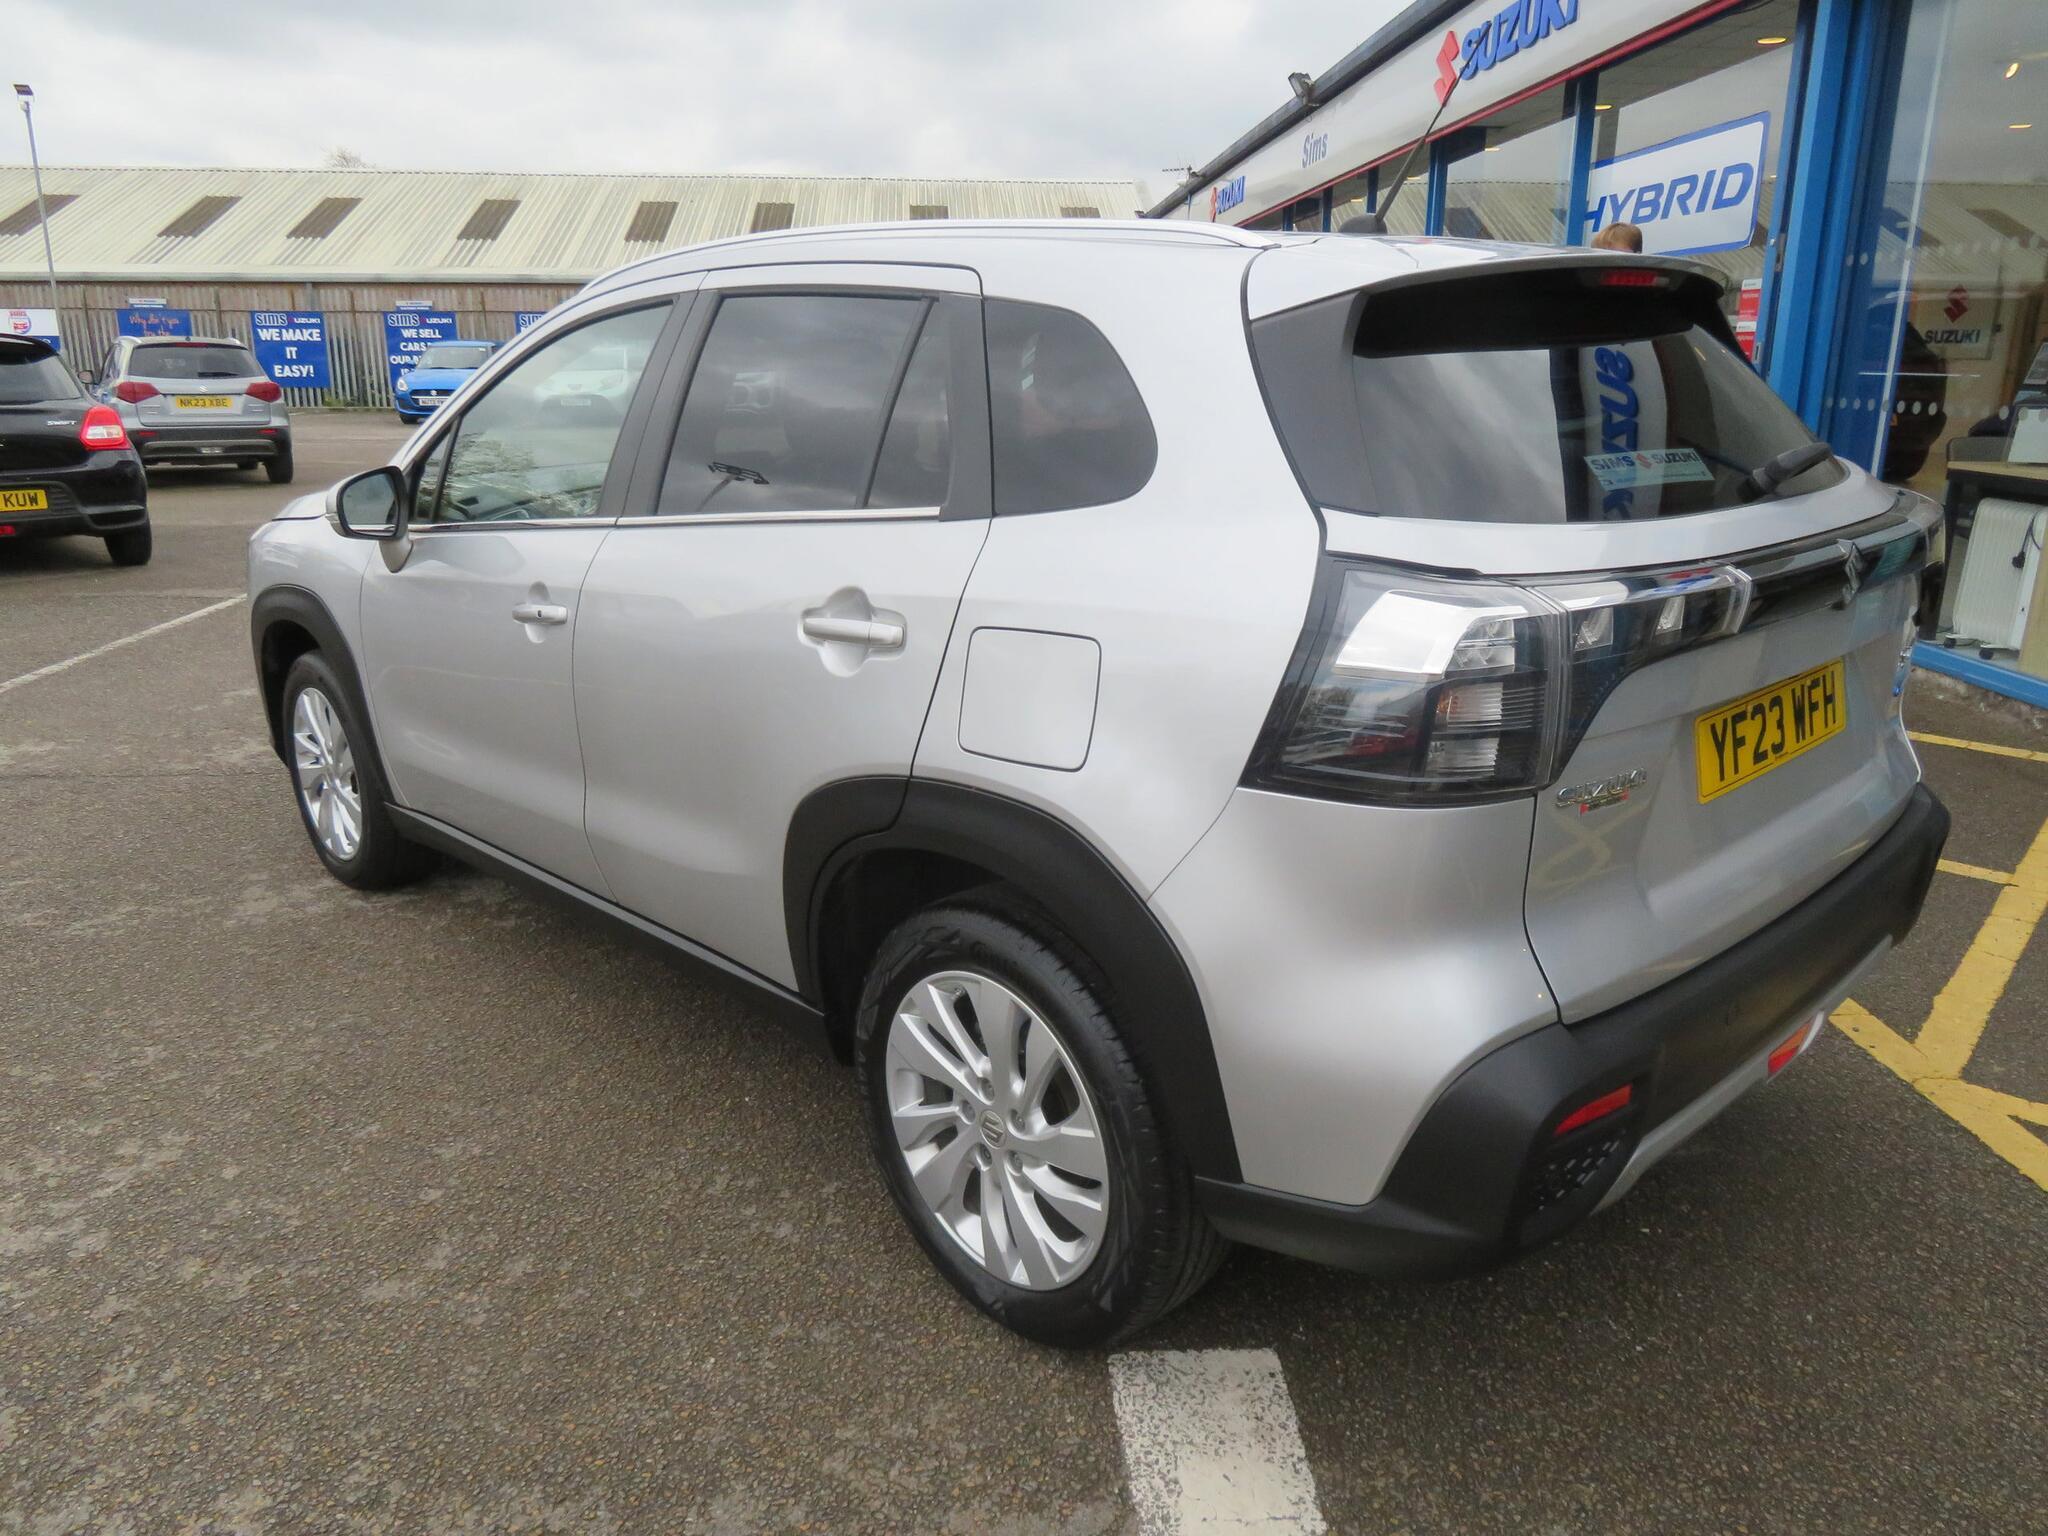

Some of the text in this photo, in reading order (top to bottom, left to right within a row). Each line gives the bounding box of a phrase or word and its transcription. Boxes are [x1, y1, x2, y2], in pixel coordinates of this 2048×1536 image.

[1302, 132, 1329, 169] Sims
[1216, 175, 1246, 215] SUZUKI
[1584, 162, 1755, 233] HYBRID
[257, 328, 322, 342] WE MAKE
[401, 328, 442, 339] WE SELL
[1925, 329, 1981, 345] SUZUKI
[285, 346, 298, 360] IT
[400, 341, 427, 352] CARS
[273, 364, 315, 378] EASY!
[1590, 455, 1636, 471] SIMS
[3, 492, 39, 508] KUW
[1710, 670, 1837, 783] YF23 WFH
